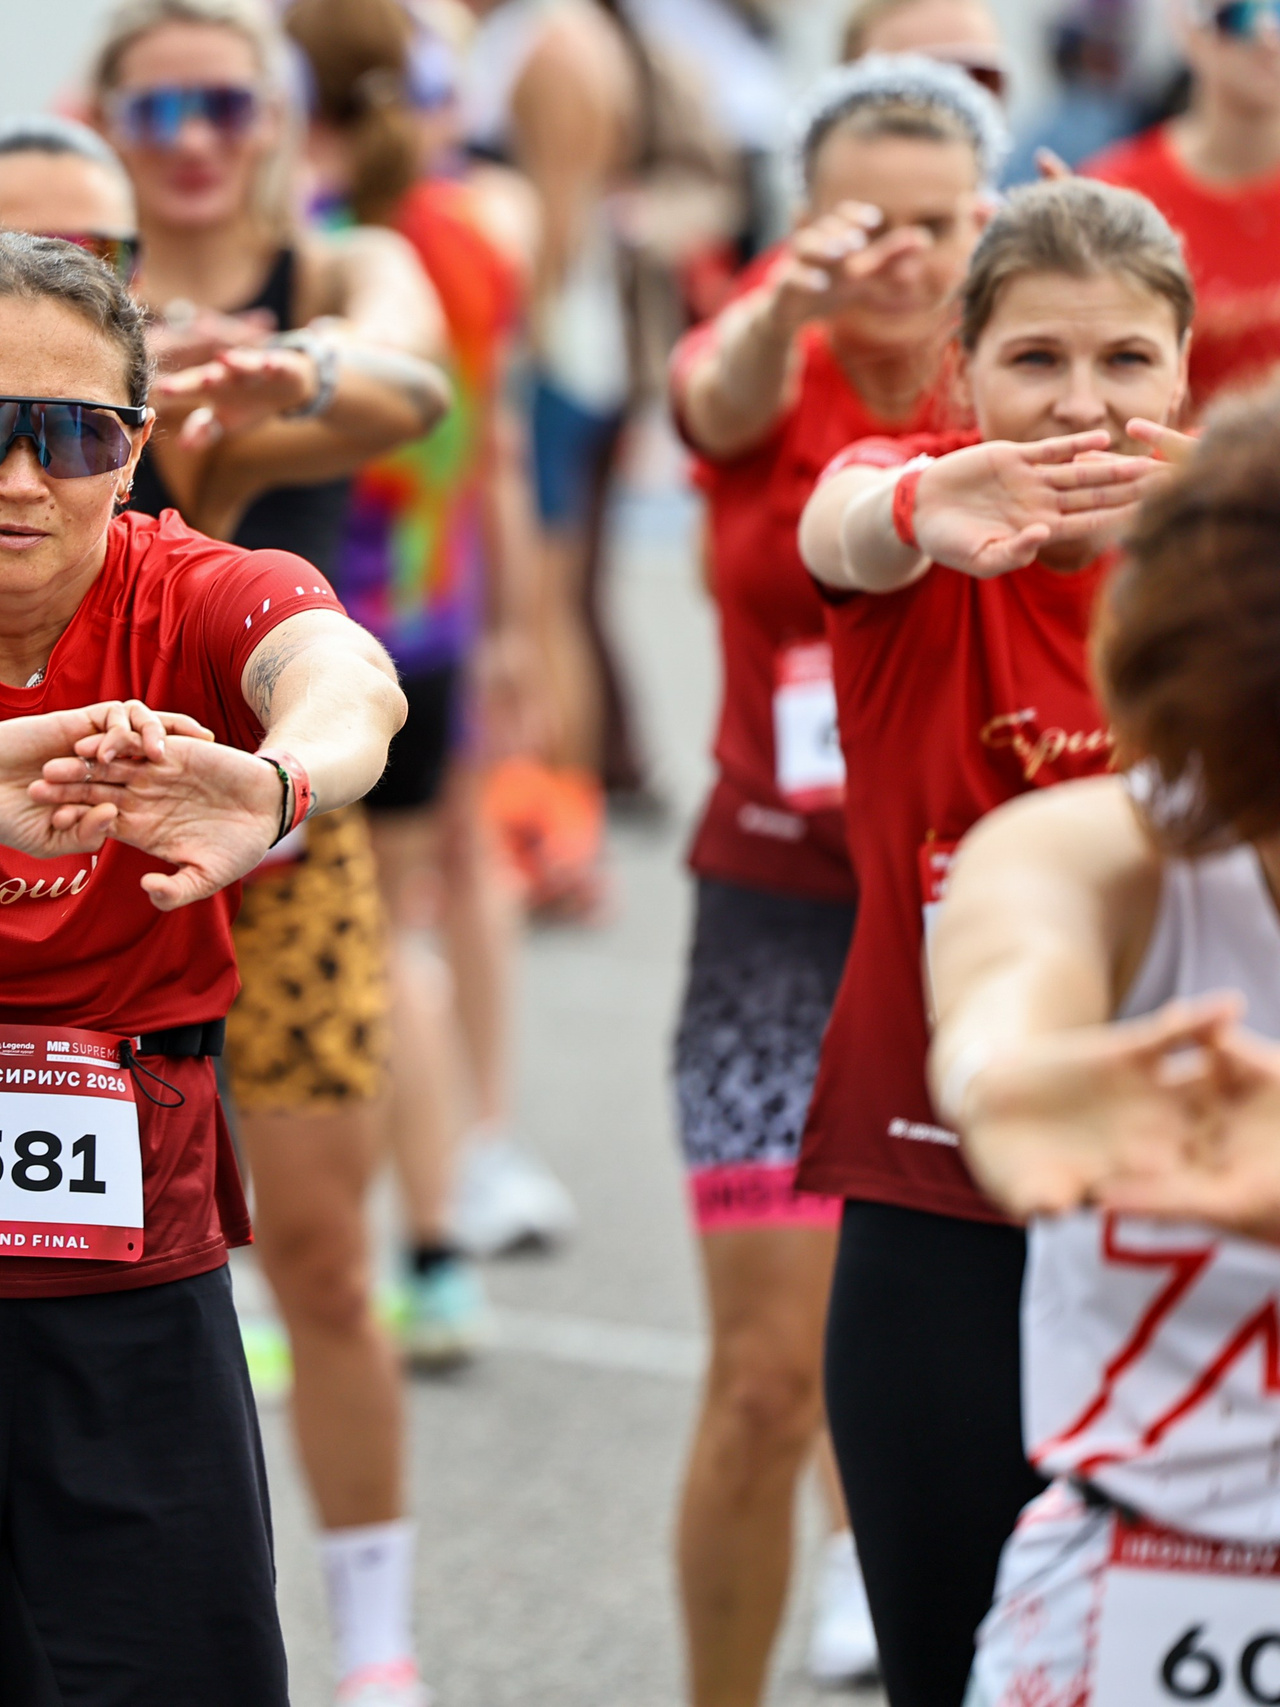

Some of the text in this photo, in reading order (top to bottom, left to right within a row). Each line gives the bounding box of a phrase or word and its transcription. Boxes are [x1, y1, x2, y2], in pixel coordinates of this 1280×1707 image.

[2, 1041, 35, 1051] Legenda
[46, 1041, 71, 1052] MIR
[86, 1072, 126, 1093] 2026
[31, 1234, 90, 1249] FINAL
